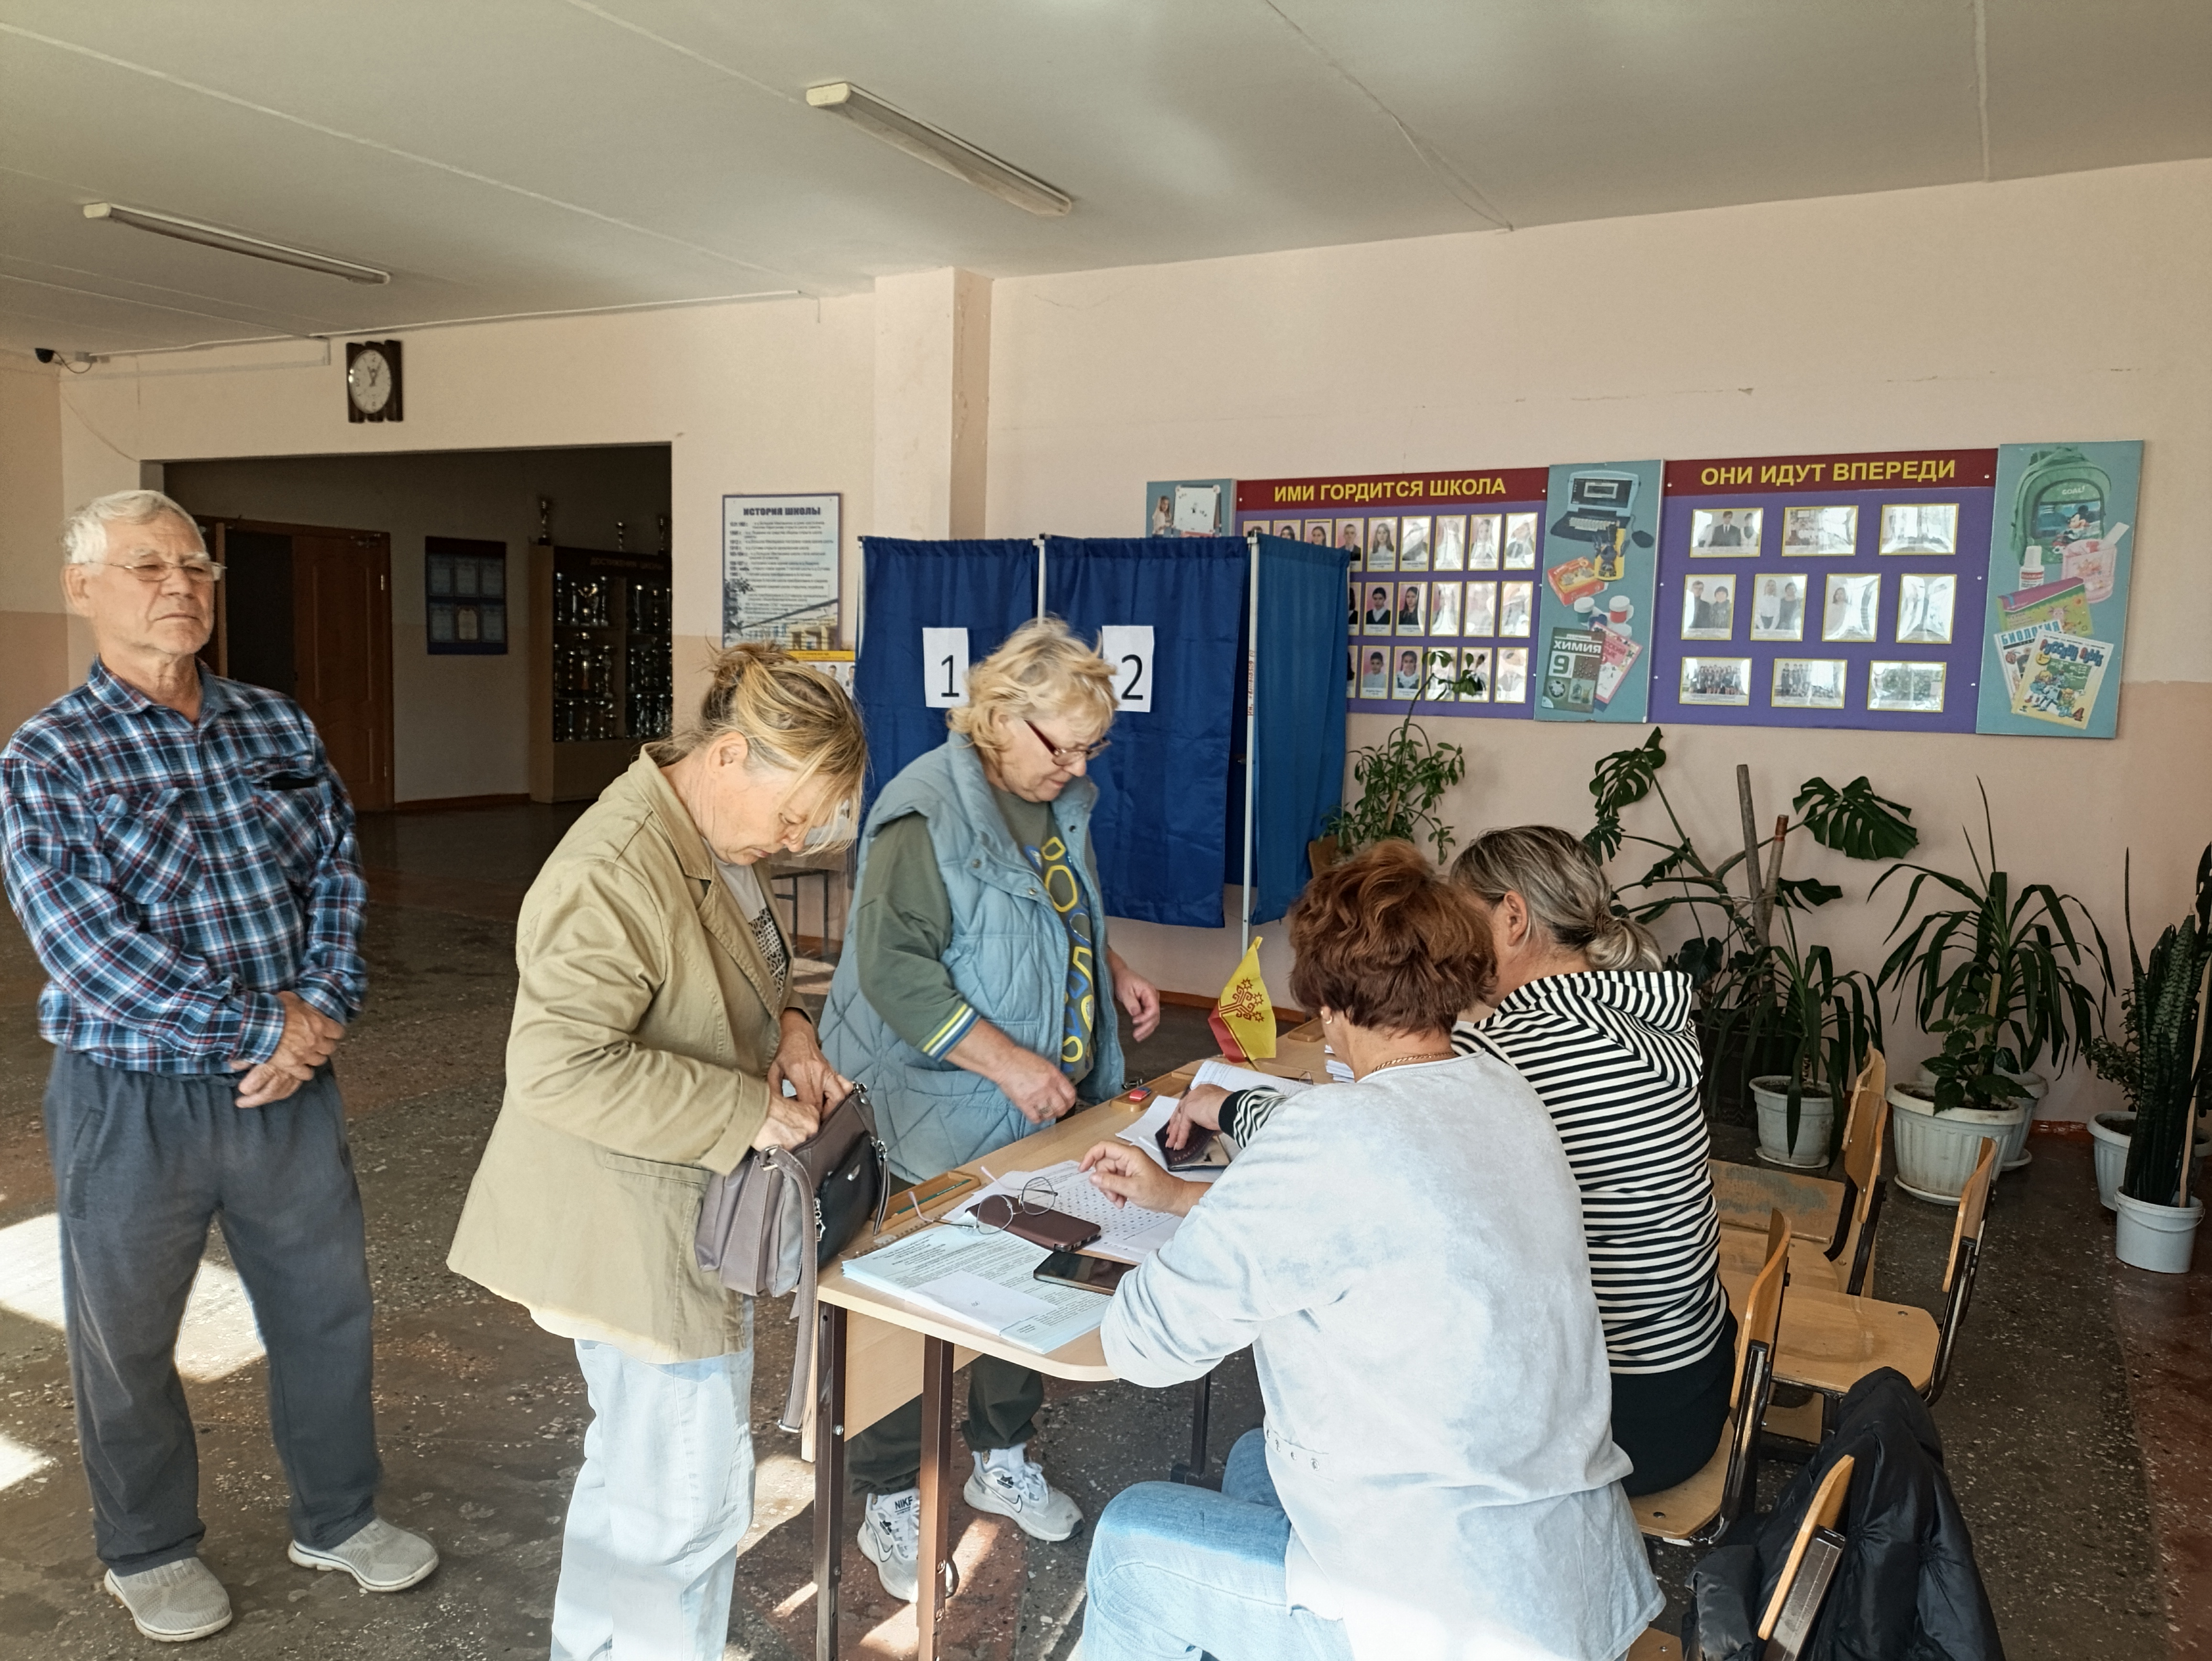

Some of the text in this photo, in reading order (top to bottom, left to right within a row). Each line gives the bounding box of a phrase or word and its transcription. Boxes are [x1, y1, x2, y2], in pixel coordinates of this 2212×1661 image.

[1701, 460, 1956, 487] ОНИ ИДУТ ВПЕРЕДИ
[1274, 477, 1506, 502] ИМИ ГОРДИТСЯ ШКОЛА
[785, 507, 821, 515] ШКОЛЫ
[1553, 640, 1602, 653] ХИМИЯ
[941, 654, 960, 698] 1
[1121, 654, 1143, 700] 2
[1553, 654, 1570, 675] 9
